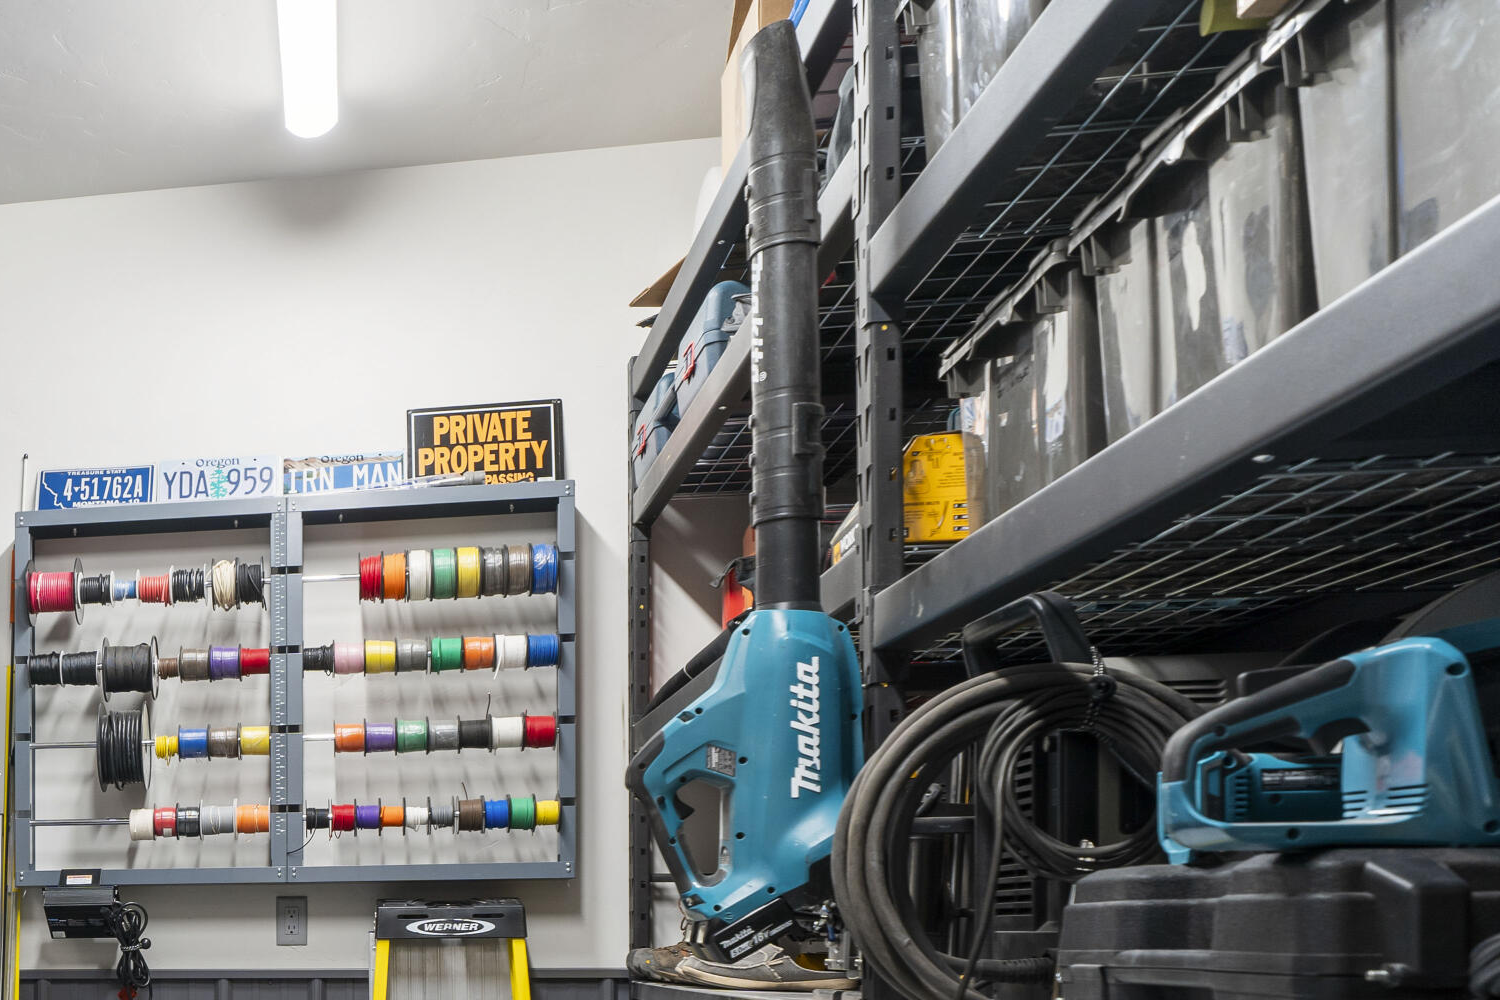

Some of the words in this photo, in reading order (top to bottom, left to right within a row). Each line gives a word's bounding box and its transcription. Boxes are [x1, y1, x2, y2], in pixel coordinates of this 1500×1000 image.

[433, 411, 532, 446] PRIVATE
[196, 458, 240, 468] Oregon
[321, 454, 364, 465] Oregon
[418, 440, 549, 477] PROPERTY
[164, 470, 210, 500] YDA
[227, 467, 273, 496] 959
[288, 467, 335, 493] IRN
[352, 462, 403, 490] MAN
[790, 656, 821, 799] makita
[424, 921, 479, 934] WERNER
